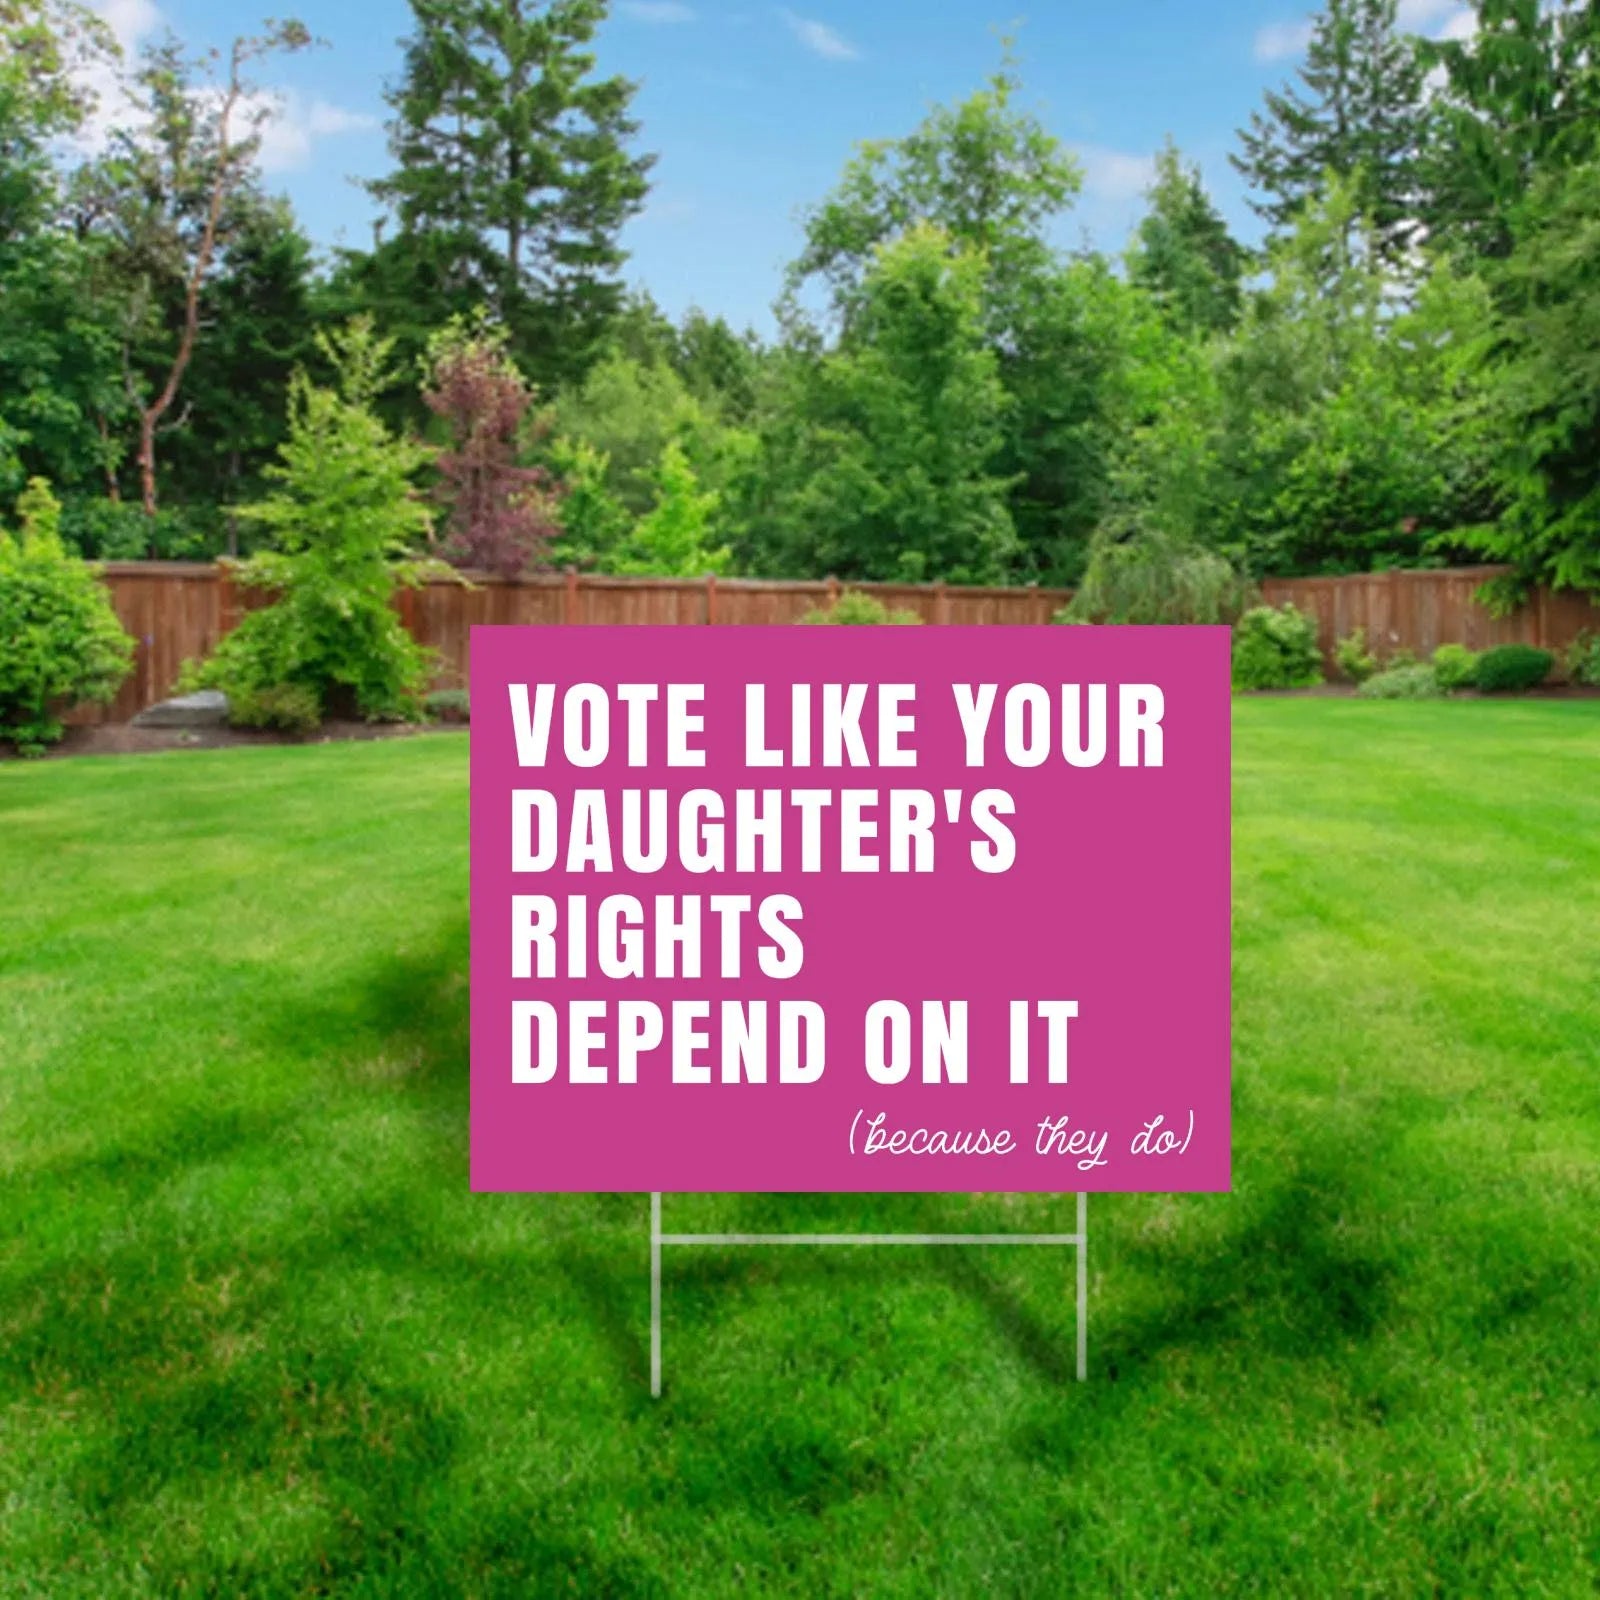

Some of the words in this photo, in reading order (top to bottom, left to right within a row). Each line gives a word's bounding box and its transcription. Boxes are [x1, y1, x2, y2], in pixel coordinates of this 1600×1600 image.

[508, 683, 706, 767] VOTE
[746, 683, 917, 767] LIKE
[952, 683, 1165, 767] YOUR
[511, 789, 1016, 873] DAUGHTER'S
[511, 894, 804, 979] RIGHTS
[511, 1001, 826, 1084] DEPEND
[865, 1000, 968, 1084] ON
[1009, 1001, 1079, 1084] IT
[849, 1110, 1016, 1155] (because
[1035, 1115, 1108, 1170] they
[1130, 1110, 1194, 1155] do)
